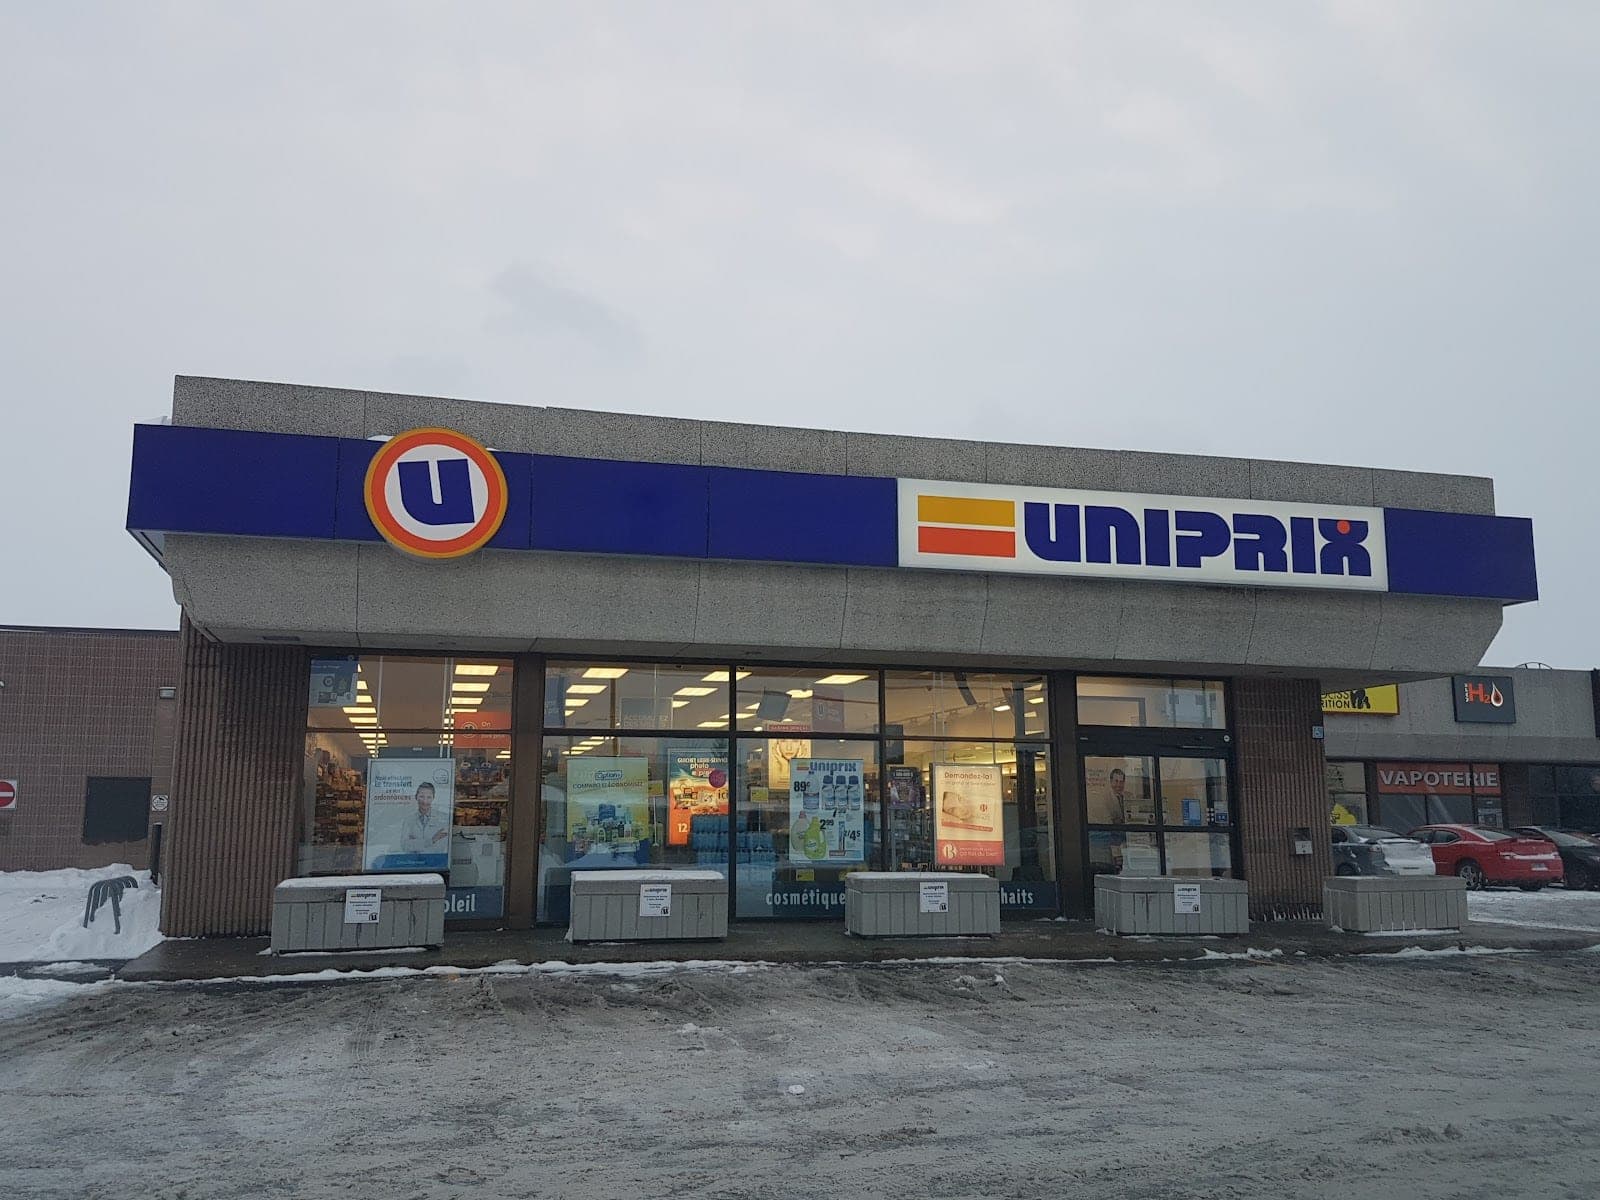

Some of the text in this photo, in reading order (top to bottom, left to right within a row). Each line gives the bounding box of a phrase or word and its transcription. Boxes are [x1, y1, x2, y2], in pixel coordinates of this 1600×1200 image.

[1023, 501, 1372, 577] UNIPRIX
[1379, 770, 1499, 787] VAPOTERIE
[677, 823, 688, 833] 12
[765, 888, 846, 910] cosmétique
